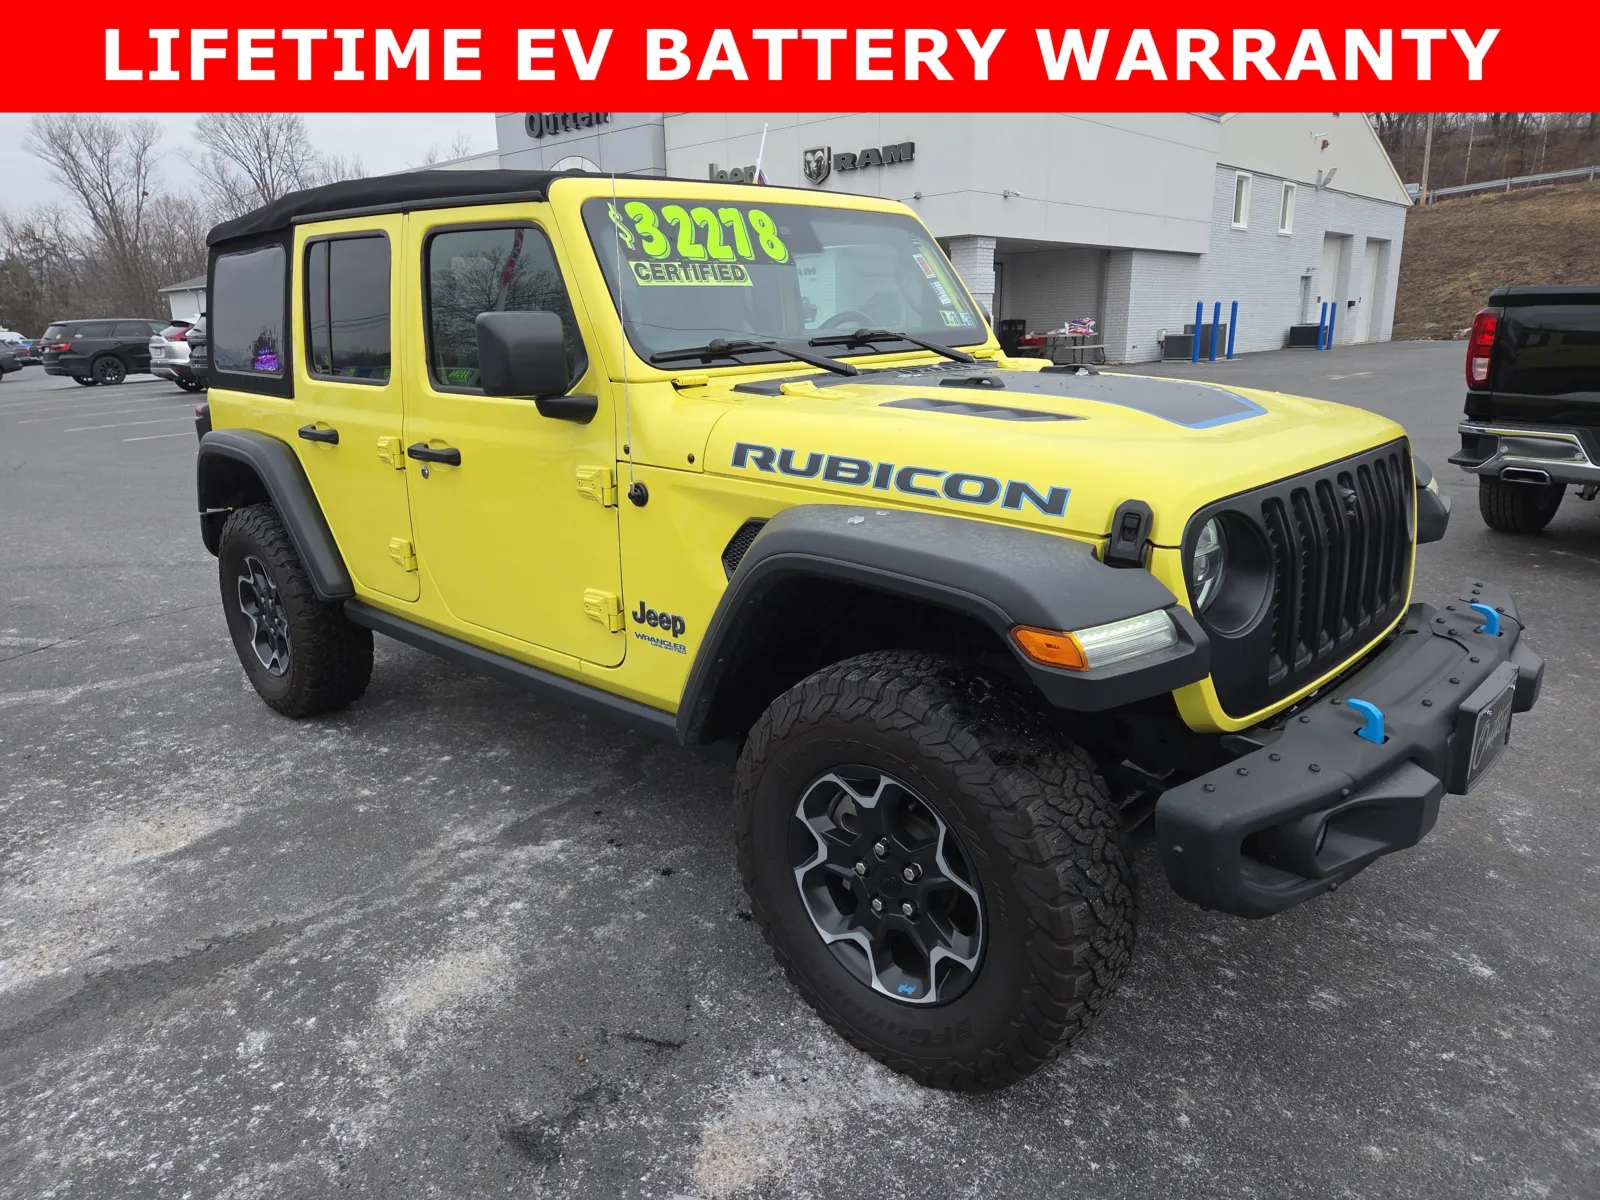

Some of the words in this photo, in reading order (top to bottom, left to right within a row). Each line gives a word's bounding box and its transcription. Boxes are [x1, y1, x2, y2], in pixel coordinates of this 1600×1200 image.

[833, 142, 915, 171] RAM
[607, 201, 789, 264] $32278
[633, 262, 749, 284] CERTIFIED
[731, 441, 1071, 518] RUBICON
[632, 600, 686, 638] Jeep
[634, 632, 687, 651] WRANGLER
